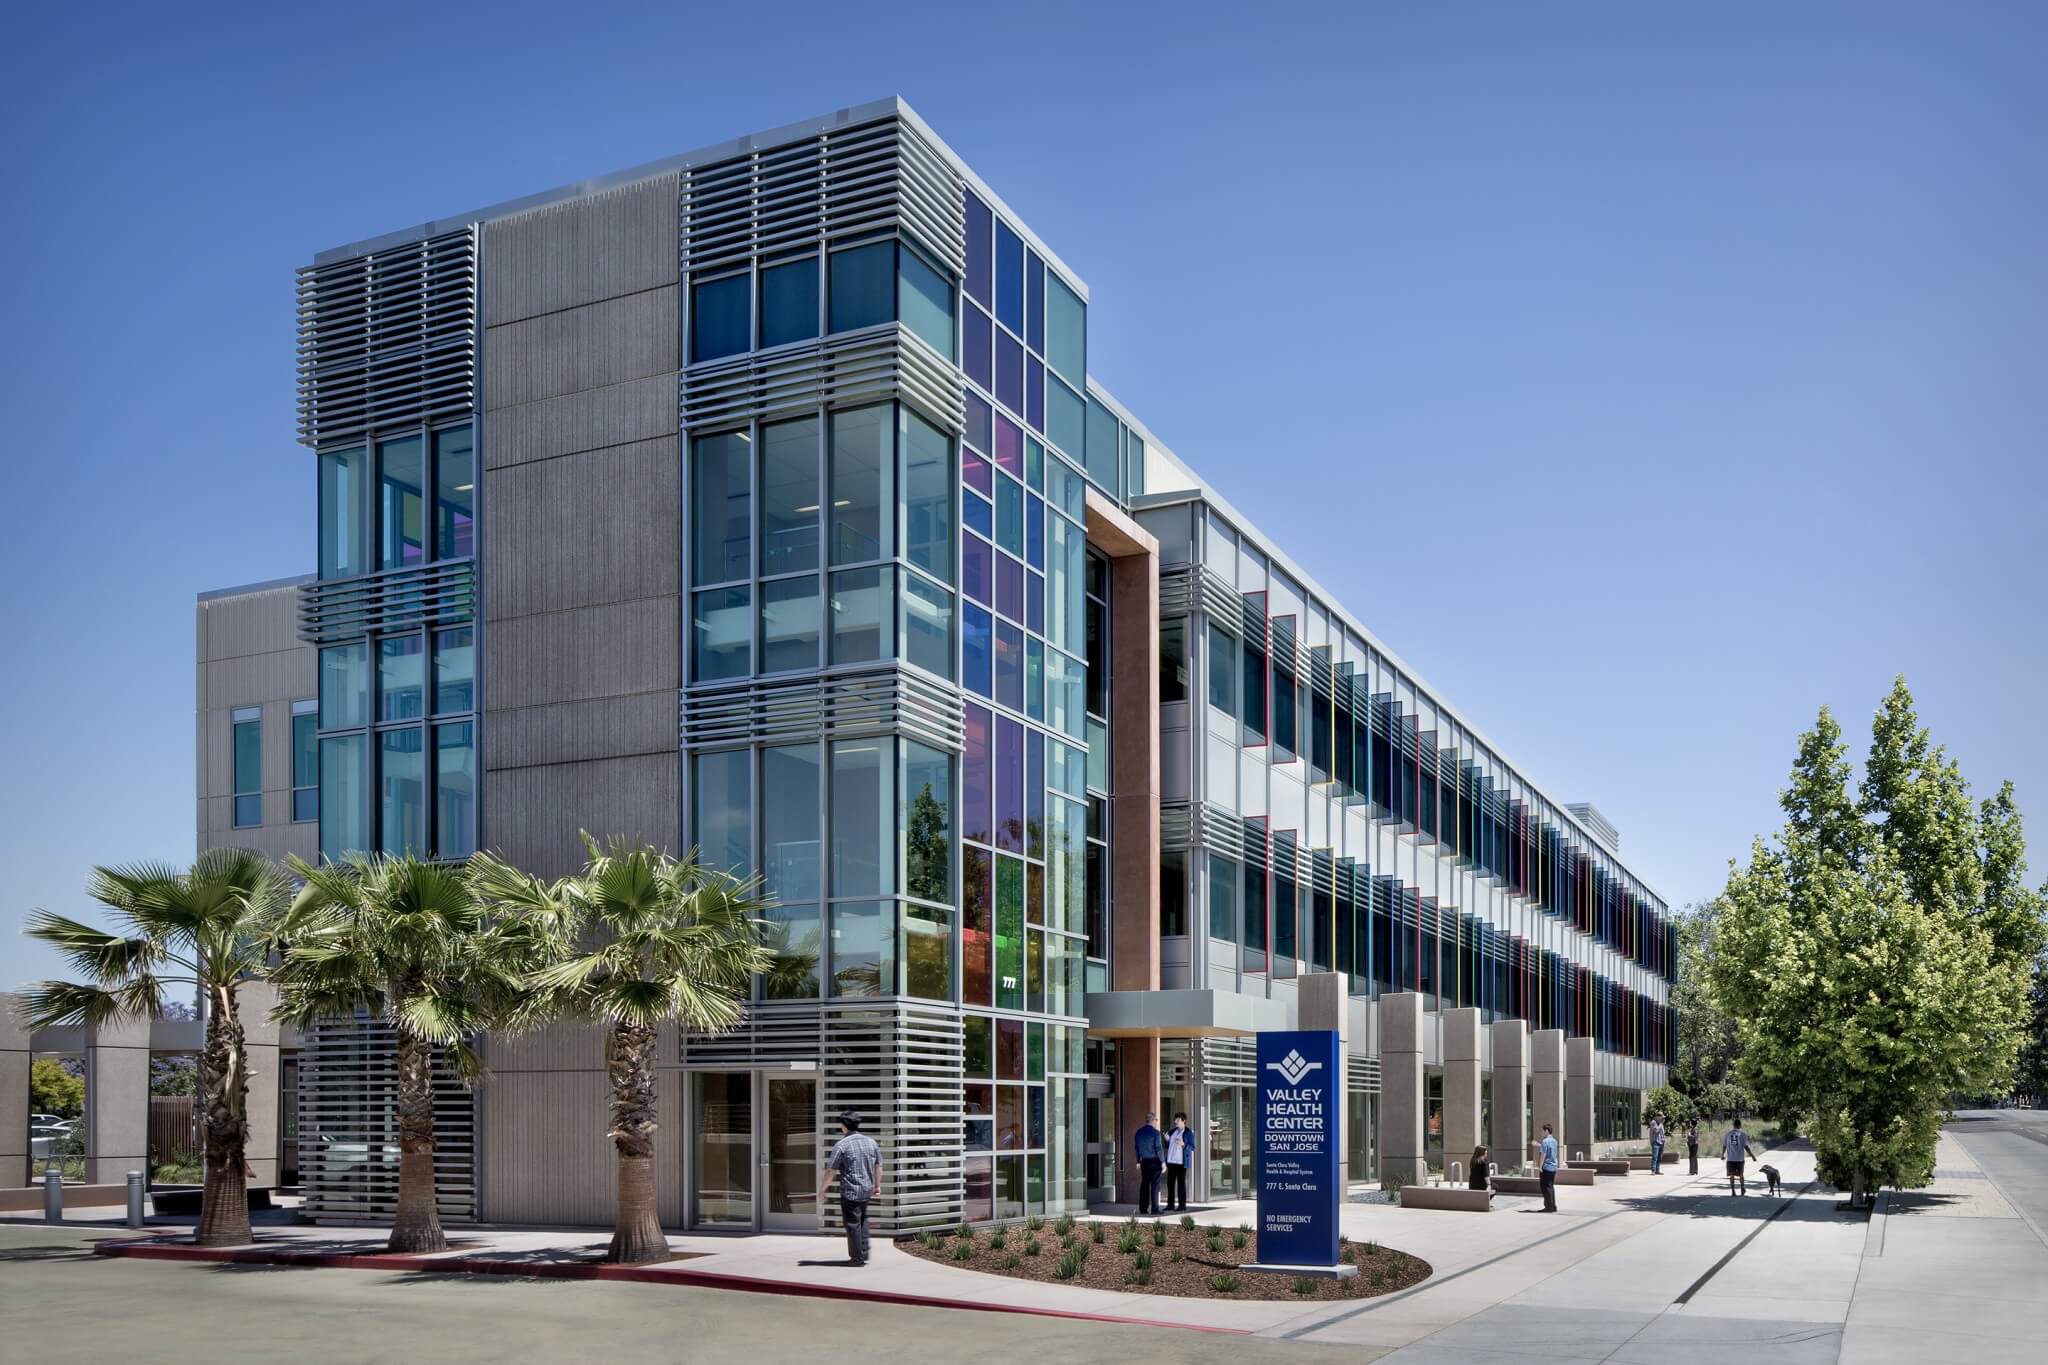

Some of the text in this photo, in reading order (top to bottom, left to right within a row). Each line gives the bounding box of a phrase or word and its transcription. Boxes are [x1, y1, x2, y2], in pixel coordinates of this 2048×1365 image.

[1003, 976, 1016, 988] 777
[1266, 1089, 1322, 1100] VALLEY
[1266, 1104, 1322, 1115] HEALTH
[1266, 1118, 1323, 1129] CENTER
